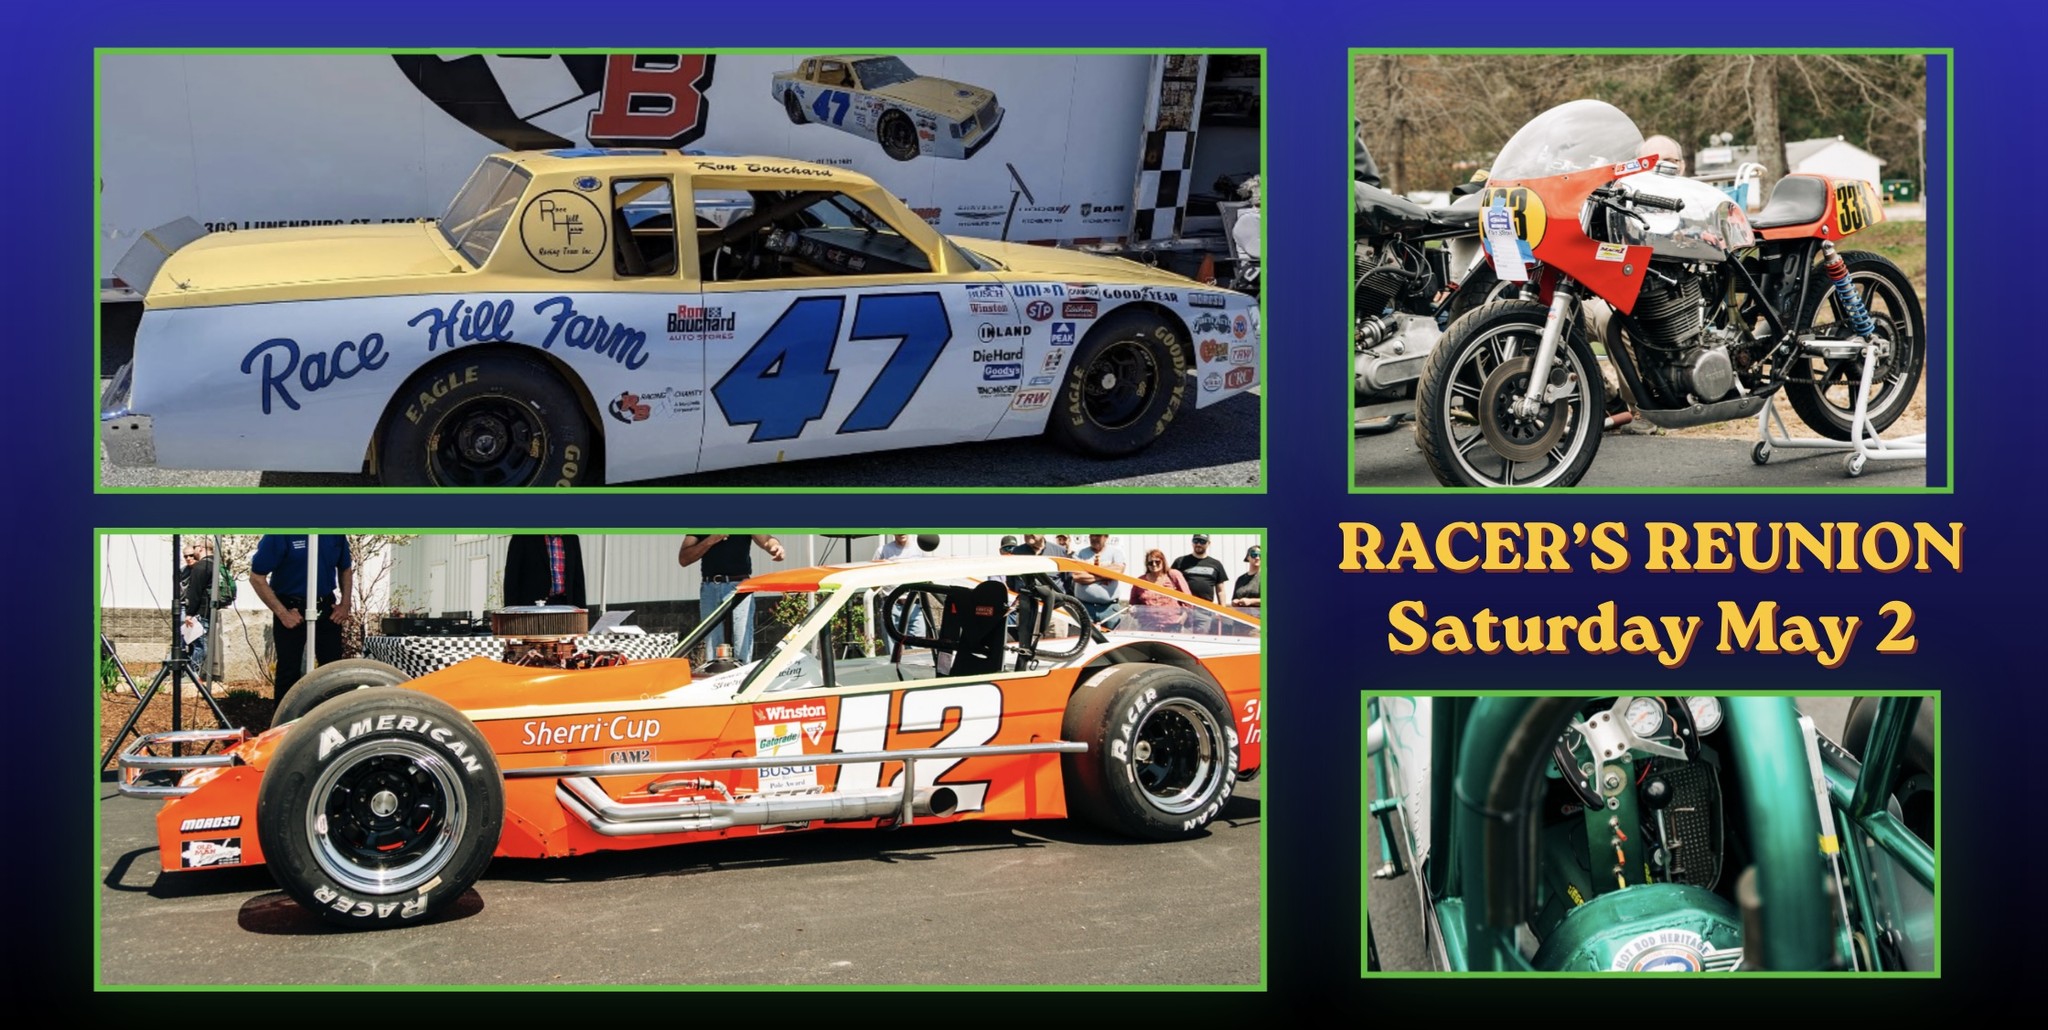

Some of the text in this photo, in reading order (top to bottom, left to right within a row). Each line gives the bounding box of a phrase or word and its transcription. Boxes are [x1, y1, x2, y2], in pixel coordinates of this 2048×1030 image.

[811, 89, 850, 126] 47
[694, 161, 833, 177] Ron Bouchard
[1093, 205, 1125, 213] RAM
[1836, 182, 1874, 233] 333
[677, 304, 707, 319] Ron
[969, 303, 1009, 313] Winston
[1028, 301, 1052, 318] STP
[666, 311, 736, 334] Bouchard
[697, 332, 734, 341] STORES
[1051, 333, 1074, 343] PEAK
[241, 296, 650, 415] Race Hill Farm
[972, 347, 1024, 362] DieHard
[710, 291, 953, 443] 47
[405, 365, 479, 425] EAGLE
[1014, 392, 1050, 405] TRW
[1069, 365, 1086, 427] EAGLE
[765, 704, 827, 721] Winston
[1111, 687, 1159, 763] RACER
[318, 714, 485, 775] AMERICAN
[759, 733, 799, 750] Gatorade
[829, 682, 1006, 813] 12
[610, 749, 650, 765] CAM2
[769, 779, 806, 789] Pole Award
[1183, 725, 1240, 832] AMERICAN
[180, 814, 242, 834] MOROSO
[313, 884, 430, 920] RACER
[1615, 948, 1632, 969] HOT
[1635, 936, 1657, 956] ROD
[1659, 932, 1711, 955] HERITAGE
